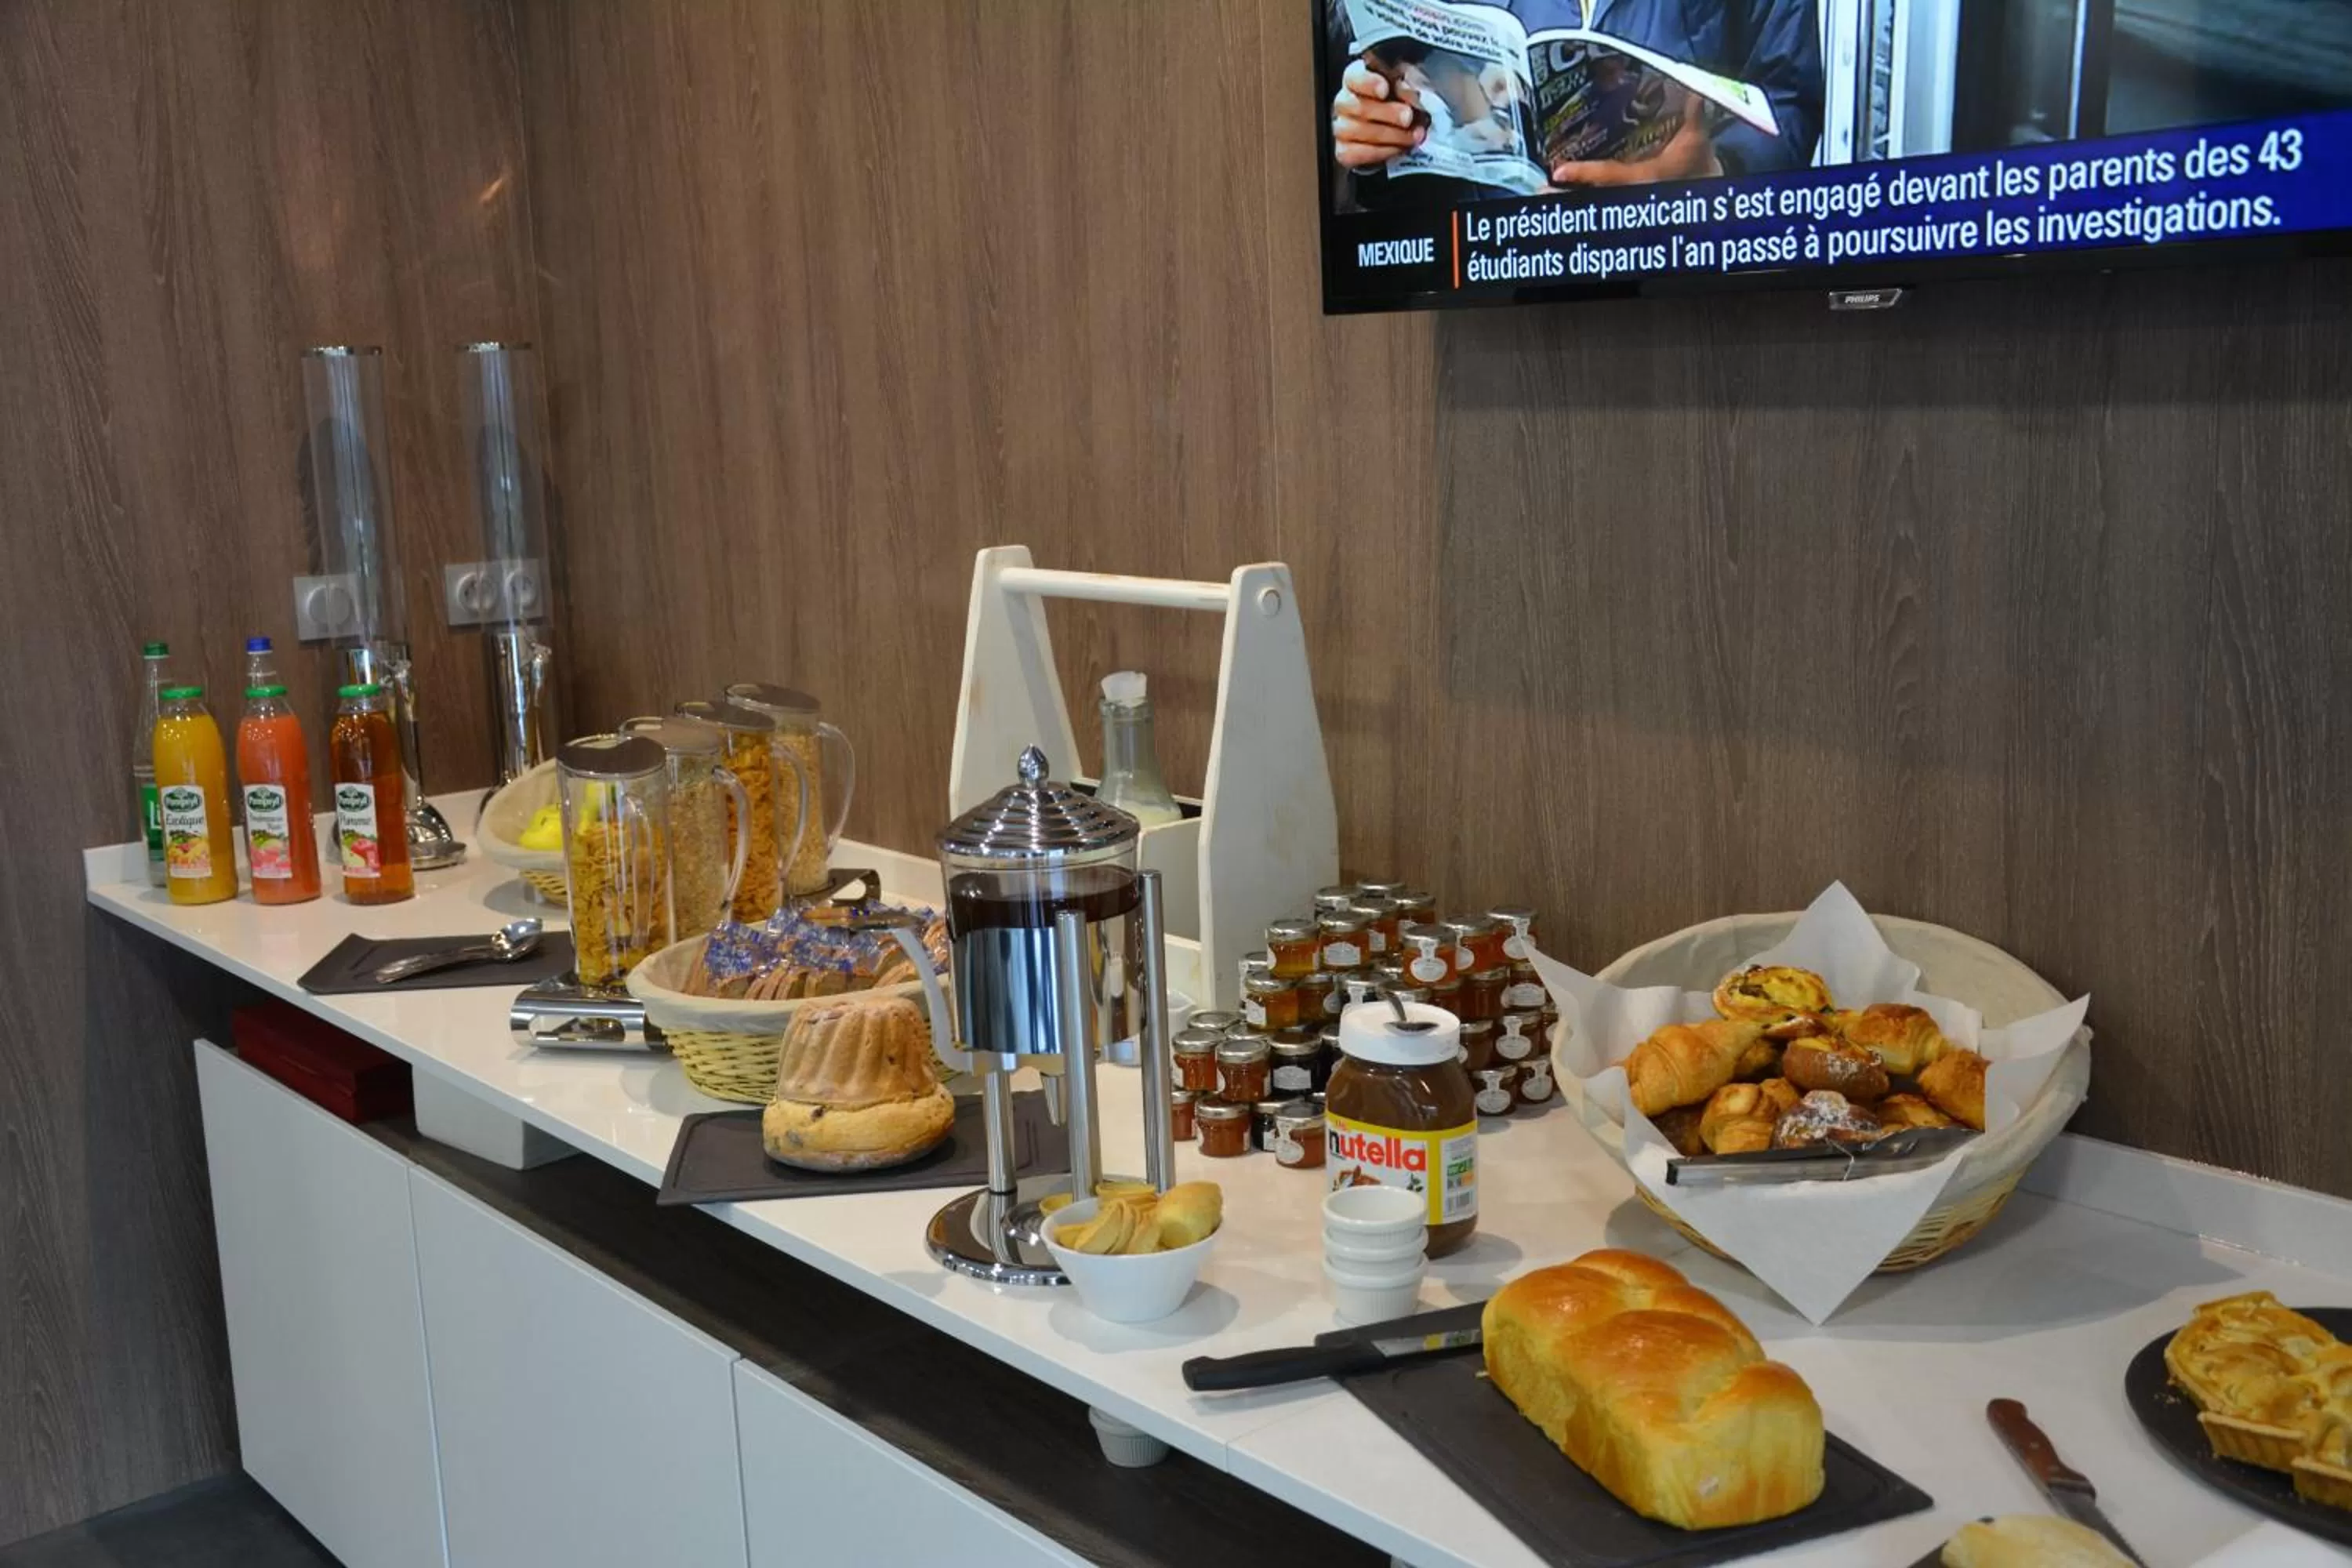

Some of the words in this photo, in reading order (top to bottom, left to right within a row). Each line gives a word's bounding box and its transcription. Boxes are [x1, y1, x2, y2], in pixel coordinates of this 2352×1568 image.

[1467, 212, 1490, 242] Le
[1495, 203, 1598, 249] président
[1602, 190, 1707, 230] mexicain
[1713, 187, 1775, 221] s'est
[1779, 172, 1881, 220] engagé
[1889, 165, 1990, 206] devant
[1995, 159, 2040, 197] les
[2049, 148, 2176, 205] parents
[2184, 138, 2250, 180] des
[2258, 128, 2303, 171] 43
[1358, 238, 1435, 267] MEXIQUE
[1467, 248, 1564, 281] étudiants
[1569, 242, 1666, 279] disparus
[1671, 235, 1715, 267] l'an
[1722, 226, 1798, 271] passé
[1804, 223, 1820, 259] à
[1828, 215, 1978, 264] poursuivre
[1986, 209, 2031, 247] les
[2038, 191, 2281, 243] investigations.
[1329, 1128, 1426, 1171] nutella
